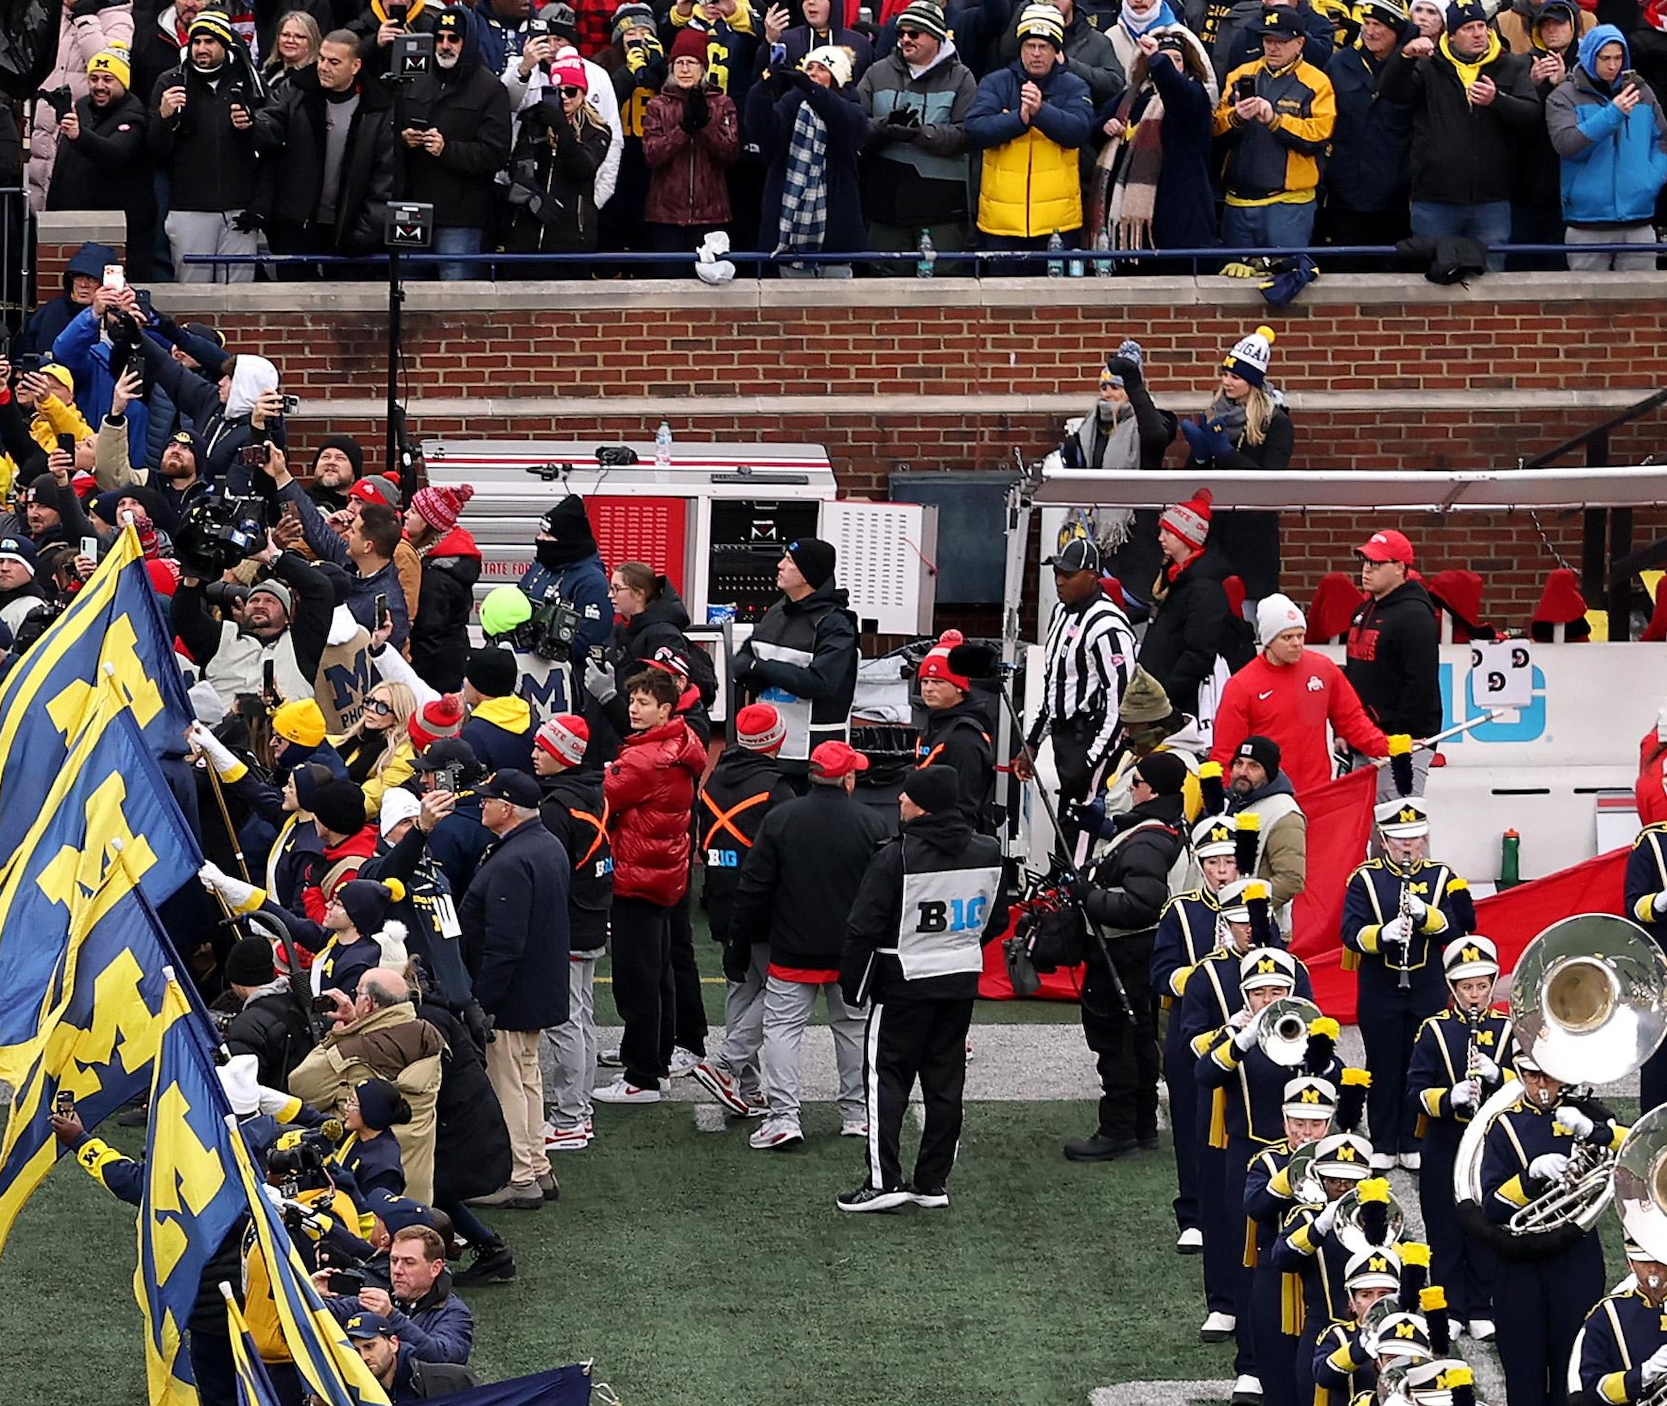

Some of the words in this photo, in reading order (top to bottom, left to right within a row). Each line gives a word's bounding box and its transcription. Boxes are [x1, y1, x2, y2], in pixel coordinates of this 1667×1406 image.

[325, 648, 375, 711] M
[523, 667, 568, 713] M
[1399, 809, 1417, 824] M
[1461, 946, 1481, 963] M
[1258, 960, 1276, 974] M
[1301, 1089, 1320, 1104] M
[1336, 1146, 1356, 1162] M
[1395, 1323, 1416, 1338] M
